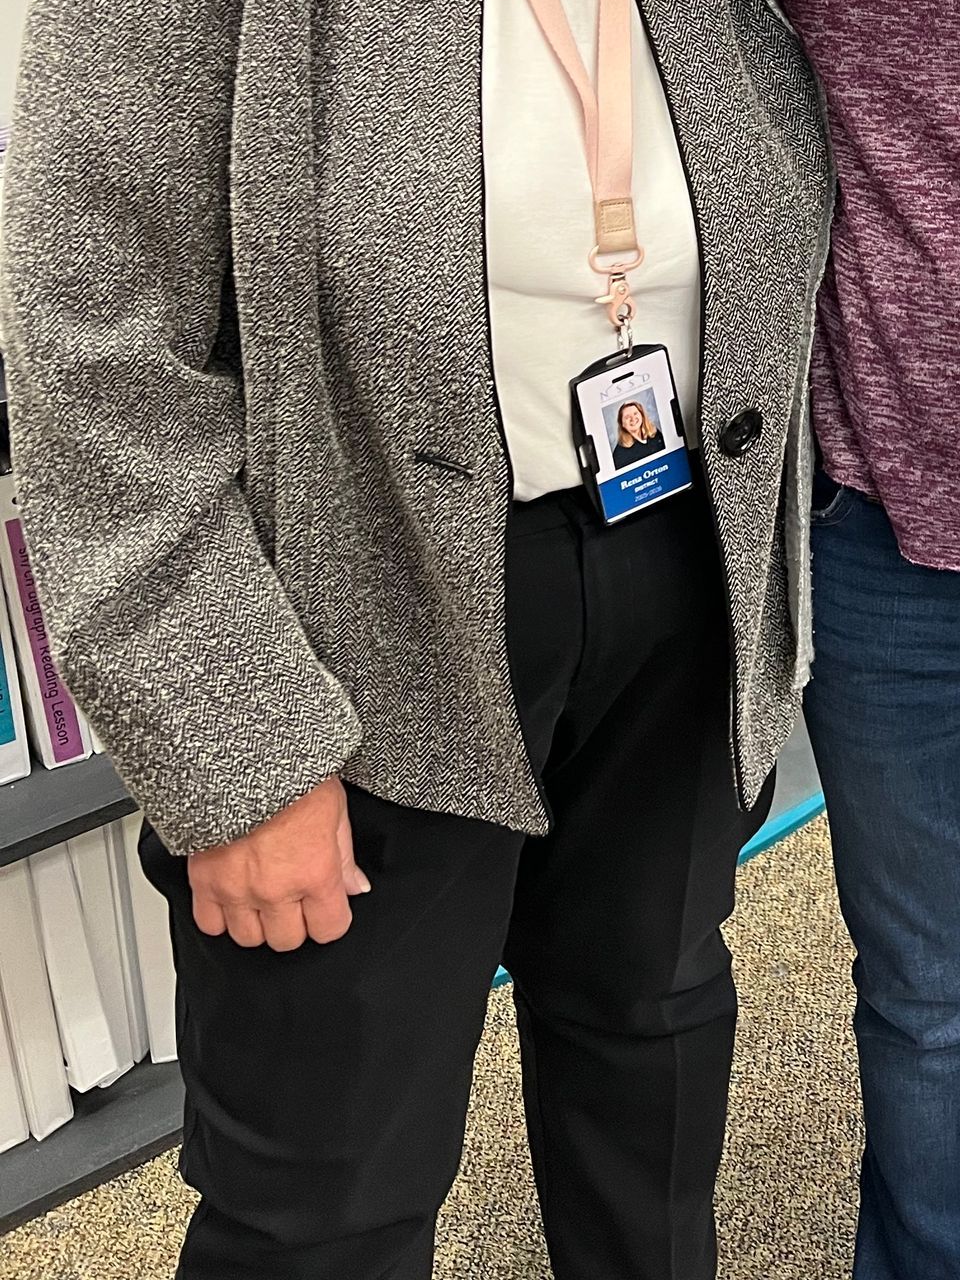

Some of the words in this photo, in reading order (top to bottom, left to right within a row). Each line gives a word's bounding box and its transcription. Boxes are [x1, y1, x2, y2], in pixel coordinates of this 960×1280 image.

[621, 476, 643, 490] Rena
[643, 464, 669, 479] Orton
[51, 698, 70, 747] Lesson
